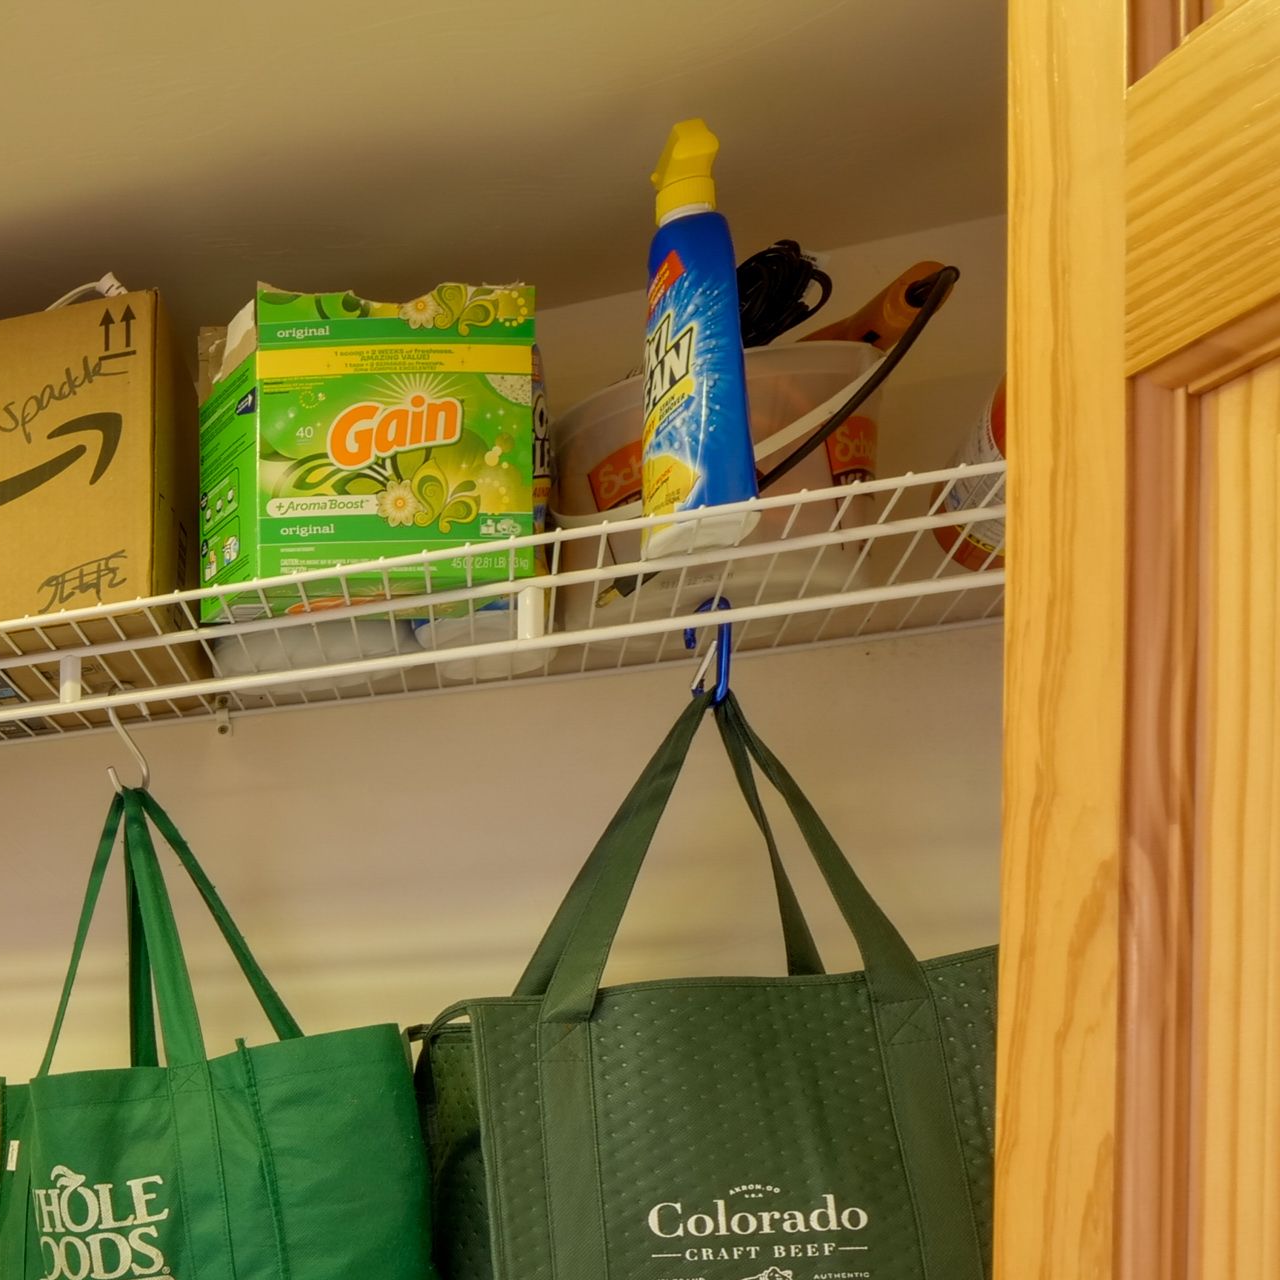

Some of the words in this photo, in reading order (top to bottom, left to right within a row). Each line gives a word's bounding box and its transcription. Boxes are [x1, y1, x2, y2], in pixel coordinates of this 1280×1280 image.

[276, 325, 330, 338] original
[295, 425, 314, 439] 40
[329, 394, 460, 467] Gain
[280, 523, 335, 536] original
[647, 1193, 869, 1238] Colorado
[685, 1246, 760, 1261] CRAFT
[773, 1242, 837, 1258] BEEF
[813, 1271, 870, 1280] AUTHENTIC
